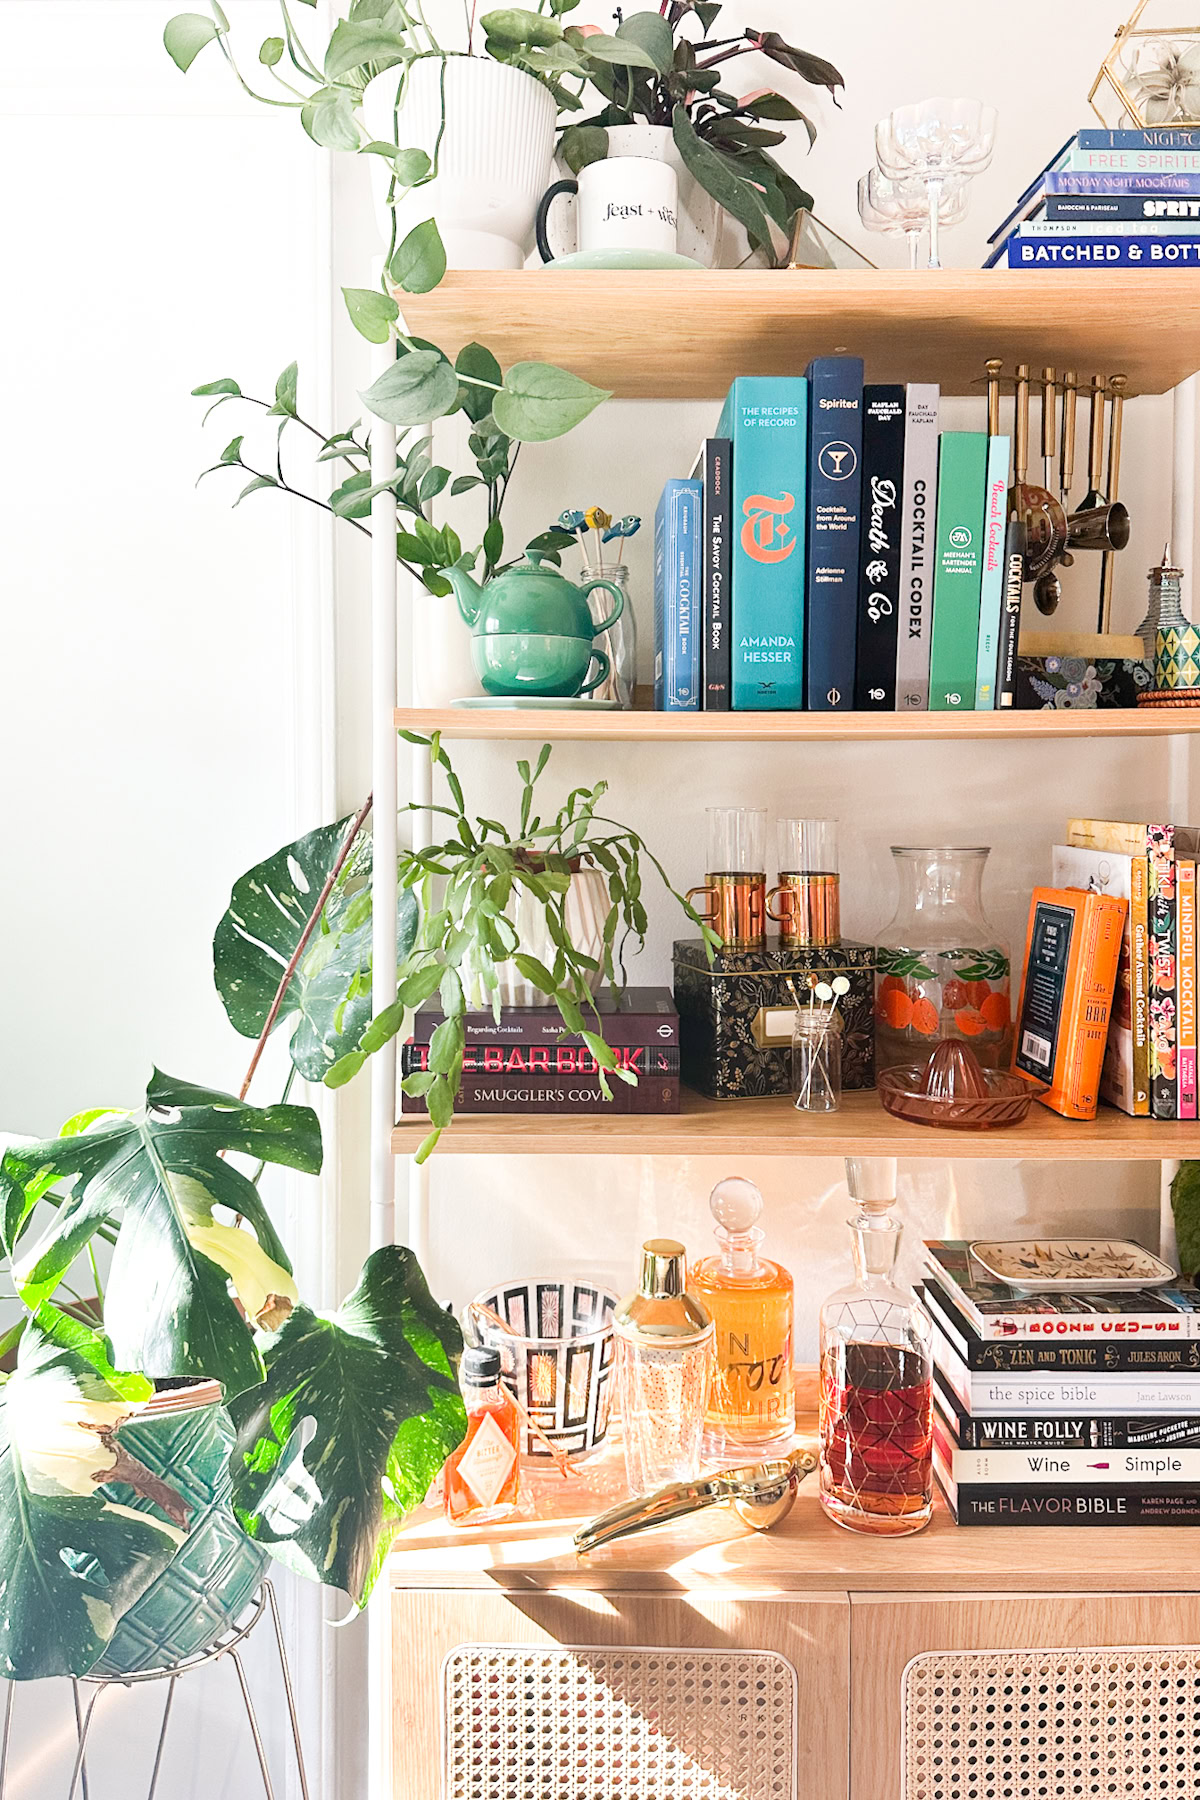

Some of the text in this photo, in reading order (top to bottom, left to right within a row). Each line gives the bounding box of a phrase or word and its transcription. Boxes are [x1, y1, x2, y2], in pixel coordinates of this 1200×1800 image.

[1088, 154, 1200, 168] FREE SPIRITE
[1057, 176, 1101, 188] MONDAY
[1103, 176, 1133, 188] NIGHT
[602, 202, 645, 221] feast
[1143, 200, 1200, 217] SPRIT
[1089, 222, 1159, 234] iced tea
[1021, 245, 1121, 261] BATCHED
[1127, 244, 1143, 260] &
[742, 407, 799, 416] THE RECIPES
[819, 398, 859, 410] Spirited
[743, 418, 797, 428] OF RECORD
[868, 475, 897, 554] Death
[711, 514, 723, 534] THE
[828, 523, 848, 531] World
[987, 480, 1005, 572] Beach Cocktails
[908, 479, 926, 639] COCKTAIL CODEX
[815, 567, 846, 575] Adrienne
[1005, 553, 1023, 614] COCKTAILS
[679, 579, 690, 637] COCKTAIL
[867, 592, 893, 624] Co
[739, 636, 796, 648] AMANDA
[743, 652, 792, 663] HESSER
[1157, 860, 1171, 889] TIKI
[1181, 895, 1193, 961] MINDFUL
[1157, 929, 1171, 977] TWIST
[1135, 924, 1146, 1048] Gather Around Cocktails
[1181, 966, 1193, 1039] MOCKTAIL
[1085, 1005, 1107, 1023] BAR
[467, 1025, 524, 1035] Regarding Cocktails
[413, 1046, 478, 1073] TE
[484, 1046, 551, 1074] BAR
[473, 1089, 566, 1102] SMUGGLER'S
[1029, 1321, 1095, 1334] BOOZE
[1101, 1321, 1180, 1333] CRUISE
[1009, 1349, 1097, 1365] ZEN AND TONIC
[1127, 1351, 1182, 1362] JULES ARON
[989, 1386, 1097, 1404] the spice bible
[1136, 1391, 1192, 1402] Jane Lawson
[982, 1421, 1028, 1439] WINE
[1034, 1421, 1084, 1439] FOLLY
[1158, 1420, 1189, 1436] PUCKETTE
[1165, 1430, 1186, 1443] JUSTIN
[1186, 1426, 1200, 1436] HAM
[1027, 1456, 1182, 1475] Wine Simple
[970, 1497, 1127, 1514] THE FLAVOR BIBLE
